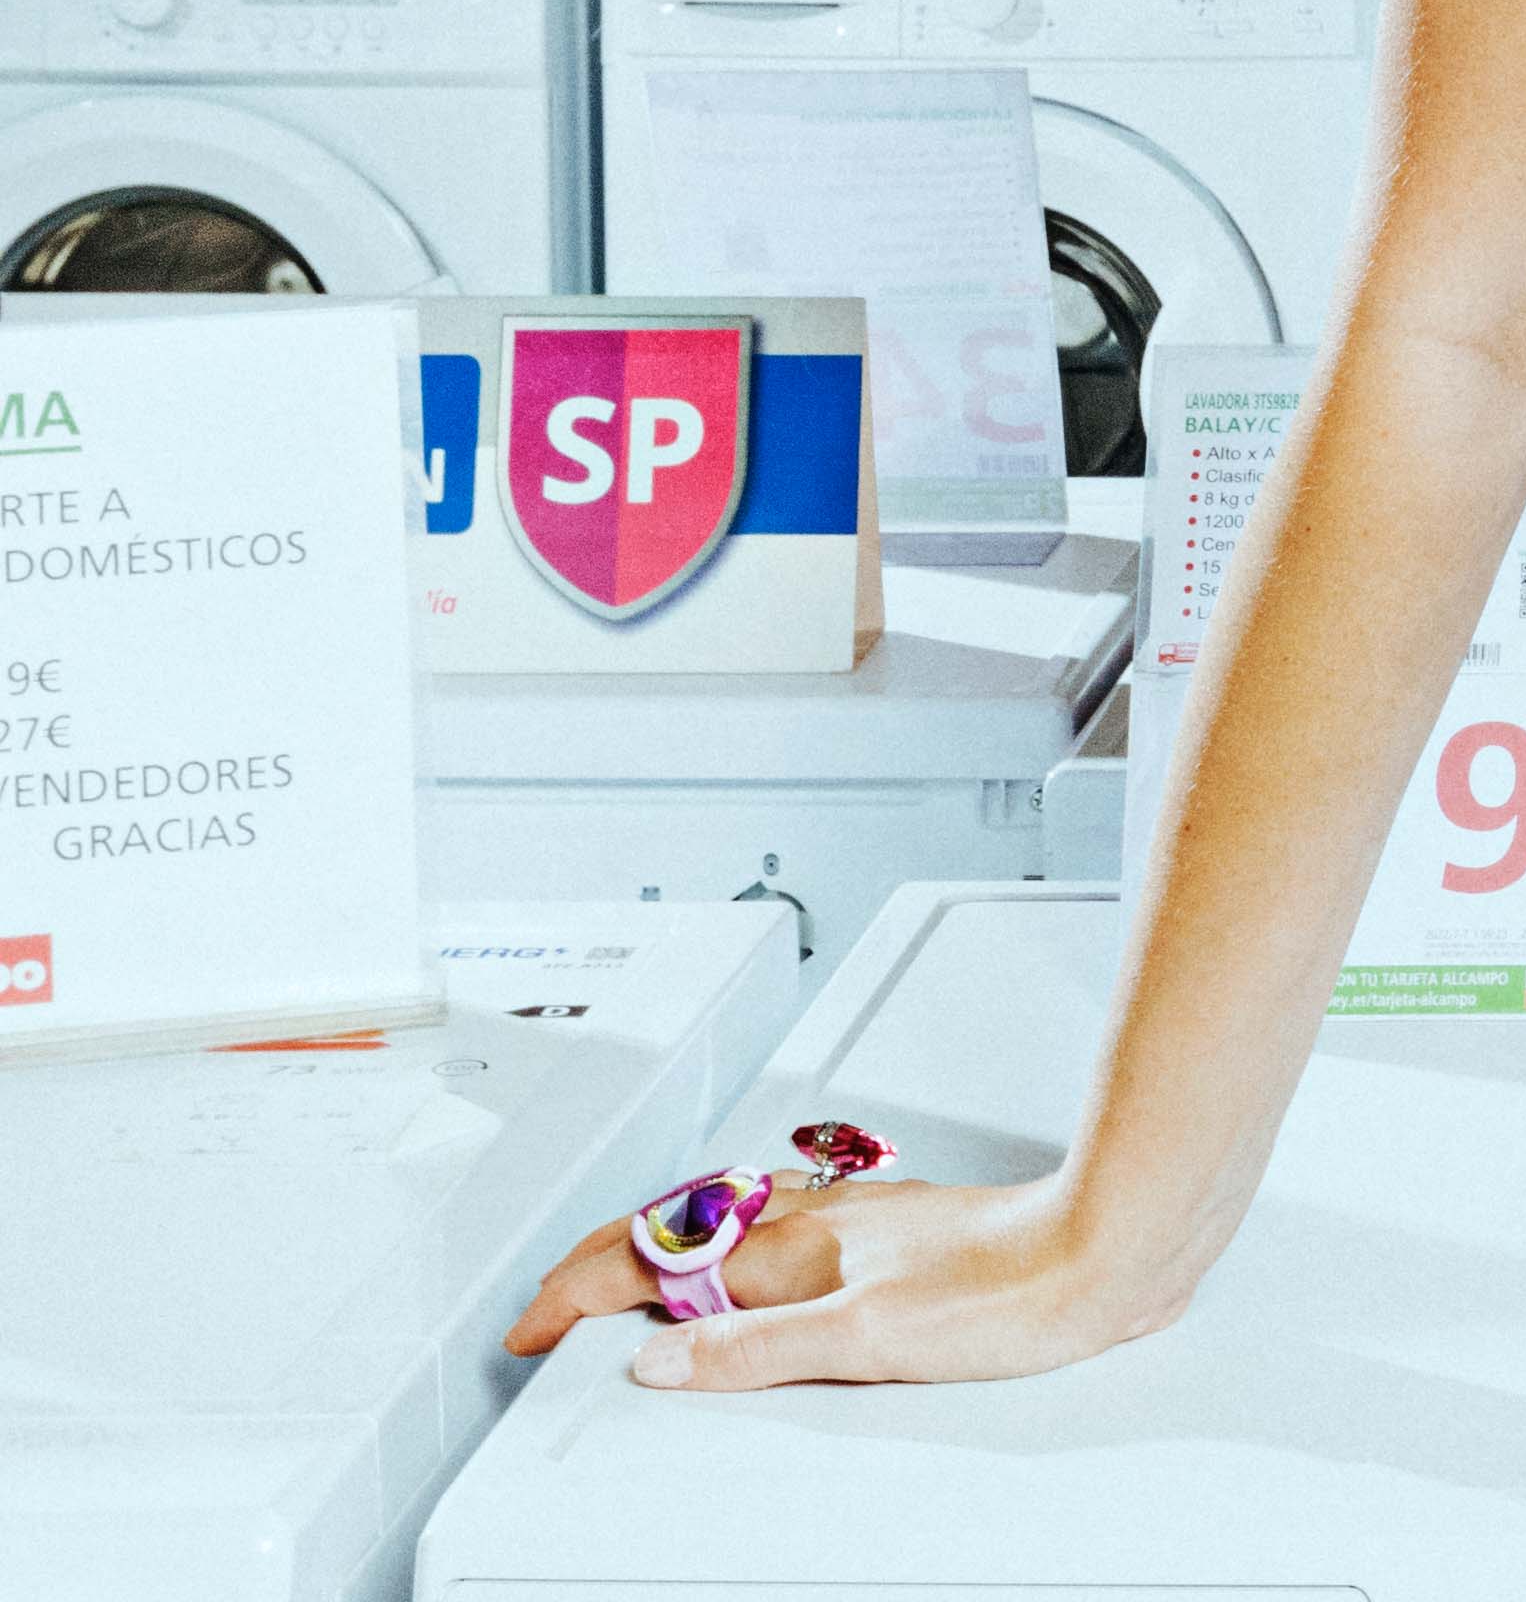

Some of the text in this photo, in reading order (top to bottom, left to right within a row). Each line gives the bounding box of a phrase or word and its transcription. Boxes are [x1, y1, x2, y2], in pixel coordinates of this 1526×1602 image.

[1185, 394, 1250, 409] LAVADORA
[541, 394, 705, 506] SP
[1206, 447, 1241, 460] Alto
[1204, 492, 1239, 508] 8 kg
[1204, 515, 1245, 528] 1200
[5, 531, 307, 583] DOMÉSTICOS
[54, 812, 256, 860] GRACIAS
